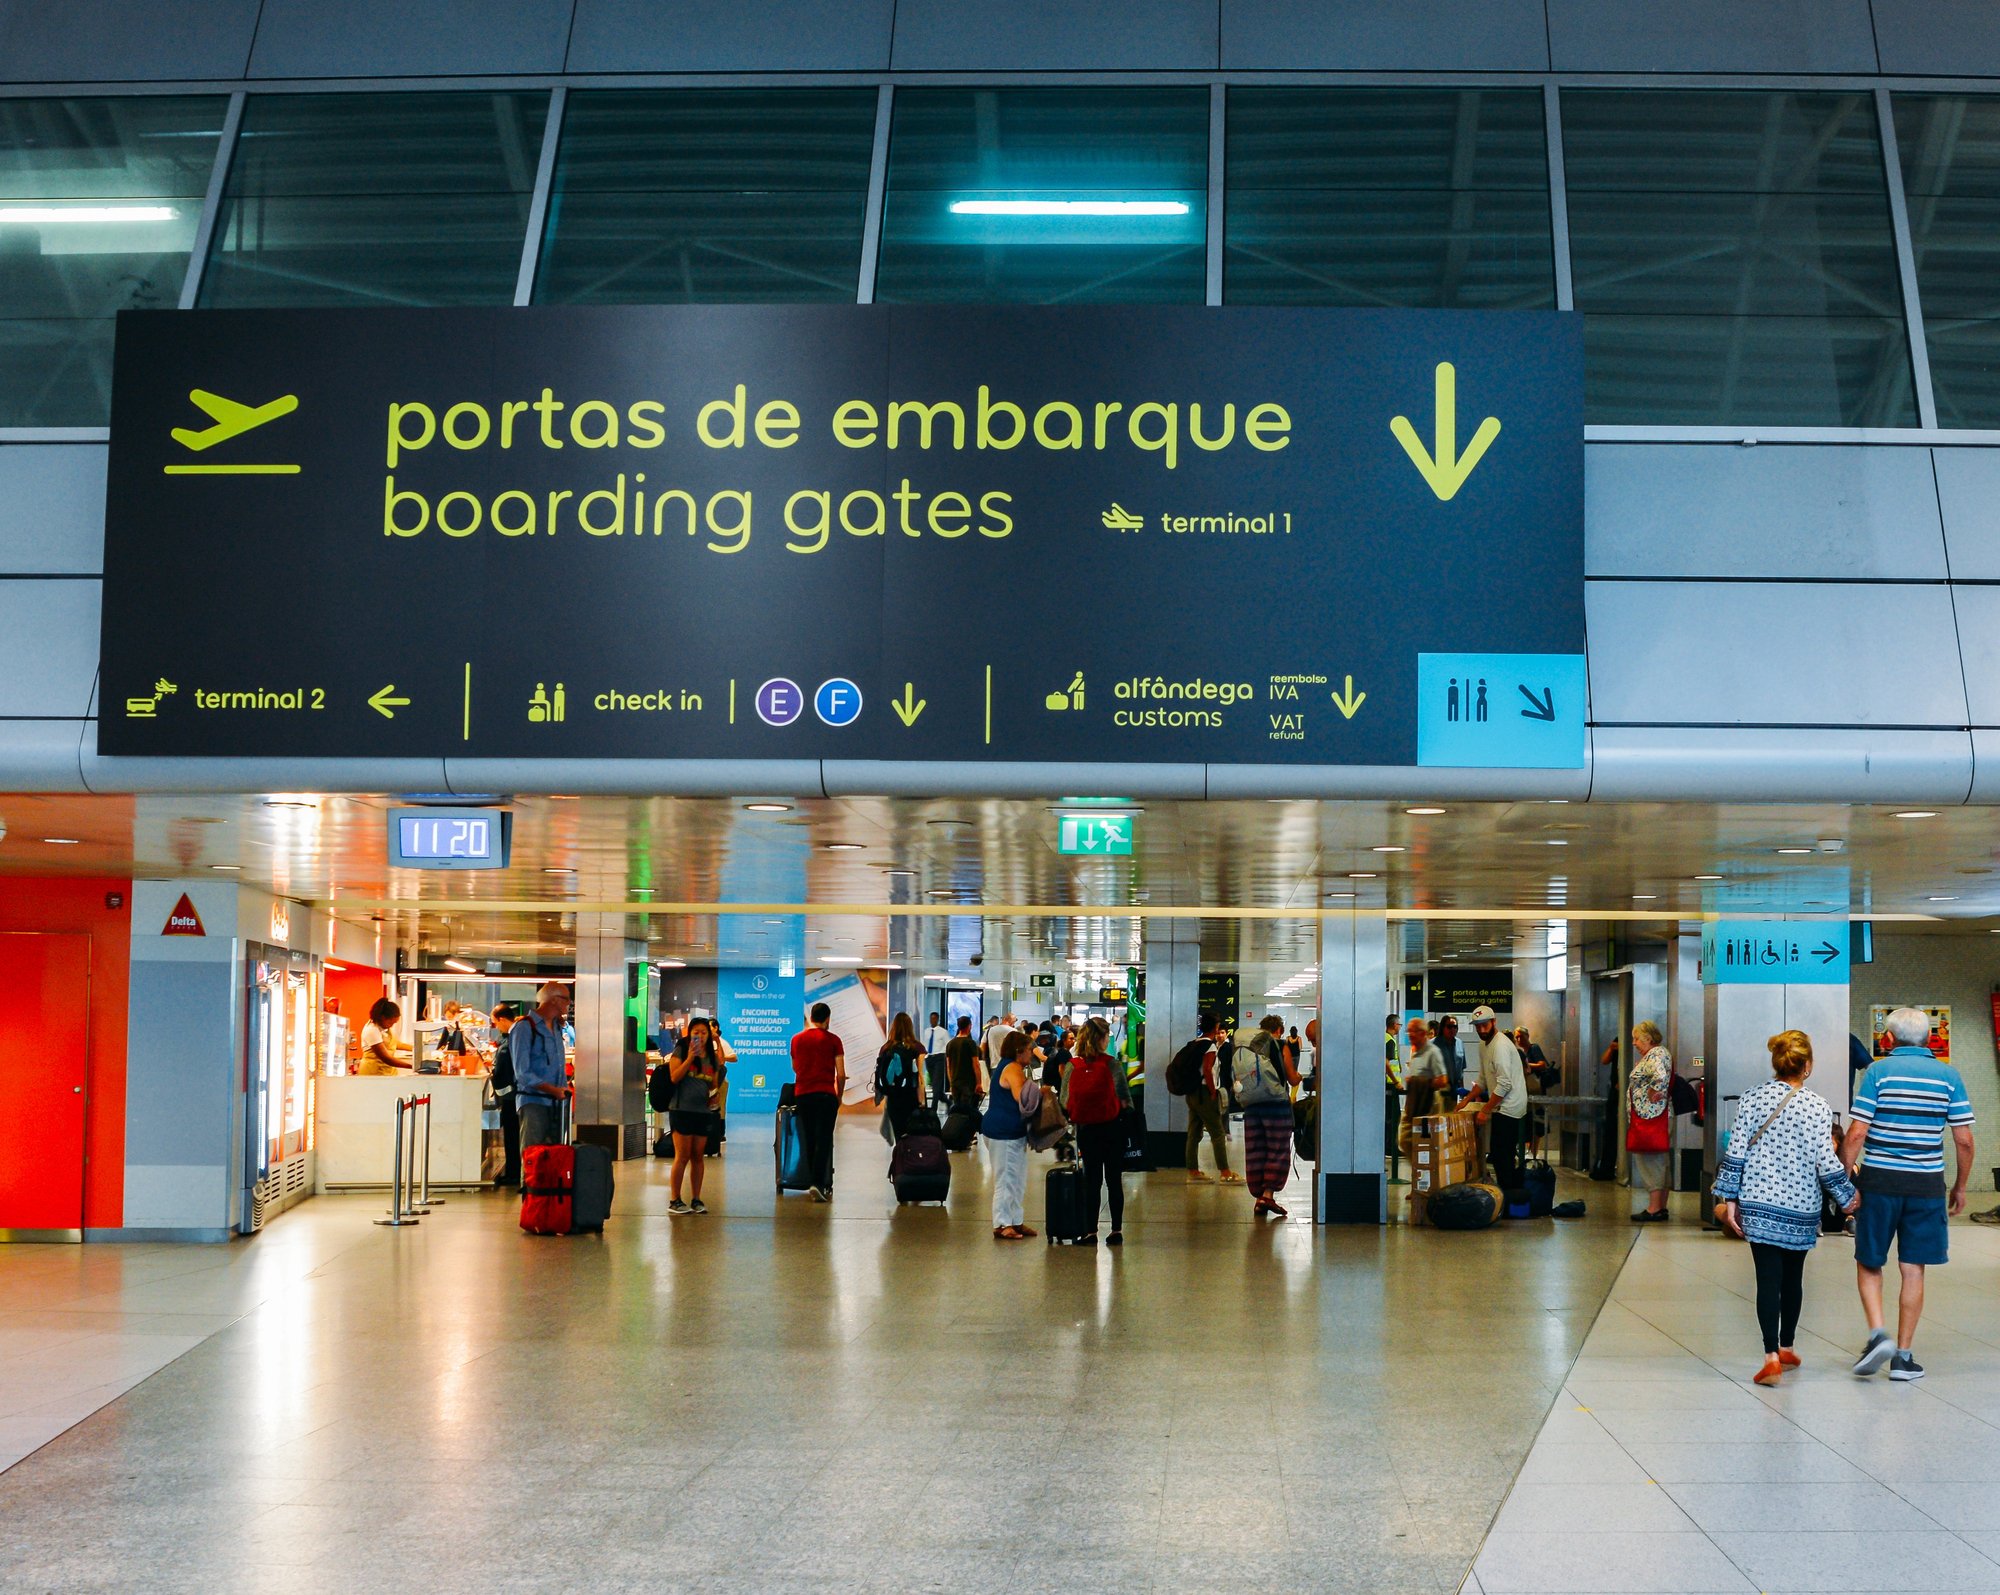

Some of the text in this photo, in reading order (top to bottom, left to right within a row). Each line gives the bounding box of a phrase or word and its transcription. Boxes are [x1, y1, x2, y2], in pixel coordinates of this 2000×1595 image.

[386, 383, 1293, 470] portas de embarque
[383, 472, 1014, 555] boarding gates
[1160, 511, 1292, 534] terminal 1
[1270, 674, 1328, 684] reembolso
[194, 686, 326, 710] terminal 2
[594, 689, 703, 711] check in
[771, 688, 848, 715] E F
[1114, 676, 1254, 706] alfândega
[1269, 684, 1299, 700] IVA
[1113, 706, 1223, 728] customs
[1269, 714, 1304, 730] VAT
[1269, 730, 1304, 740] refund
[450, 821, 487, 855] 20
[171, 916, 197, 926] Delta
[1452, 989, 1478, 997] portas
[749, 1025, 782, 1033] NEGÓCIO
